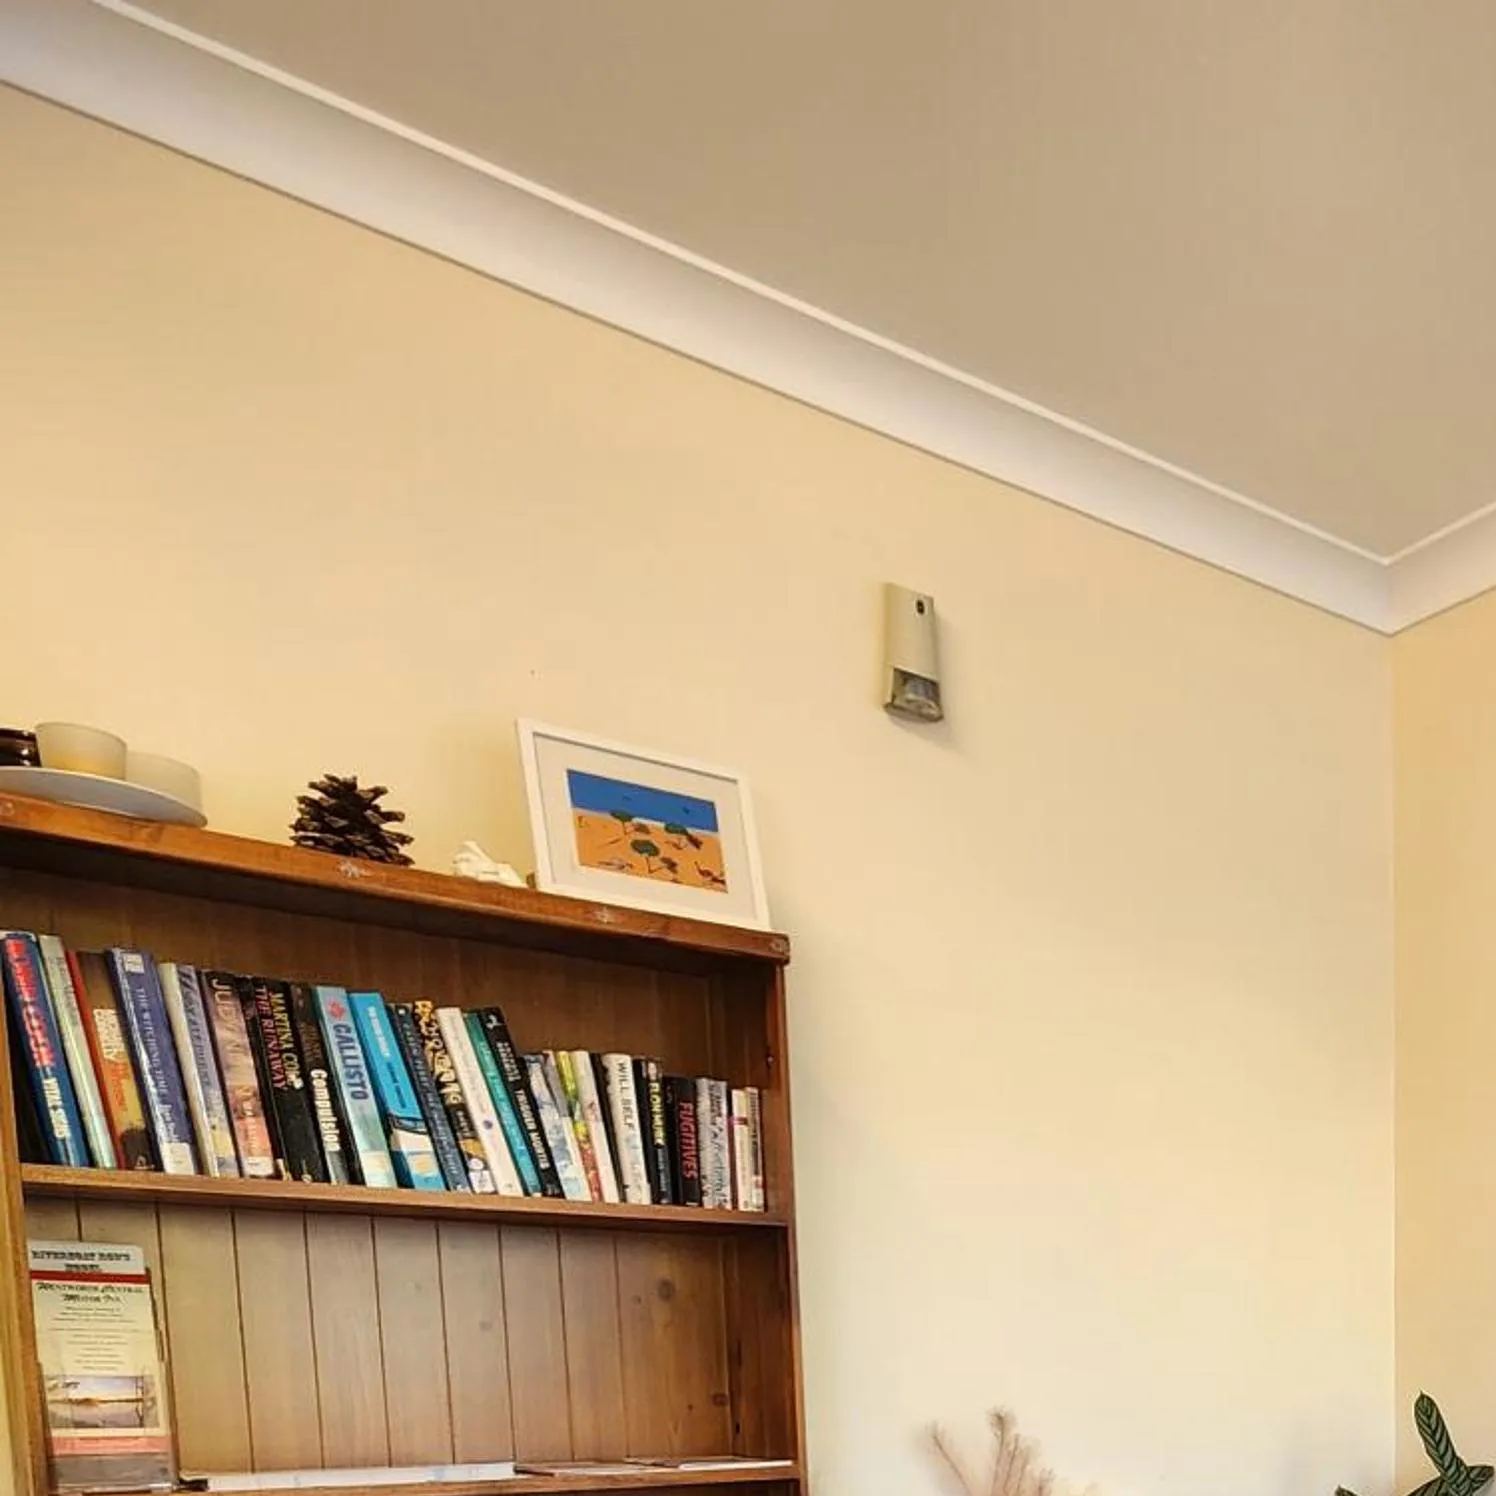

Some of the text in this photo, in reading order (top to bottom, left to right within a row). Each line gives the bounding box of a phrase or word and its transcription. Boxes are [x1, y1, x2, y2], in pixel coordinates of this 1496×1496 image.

[261, 1019, 288, 1091] RUNAWAY
[271, 992, 294, 1050] MARTINA
[333, 1023, 368, 1101] CALLISTO
[616, 1061, 629, 1093] WILL
[310, 1068, 341, 1152] Compulsion
[679, 1101, 698, 1179] FUGITIVES
